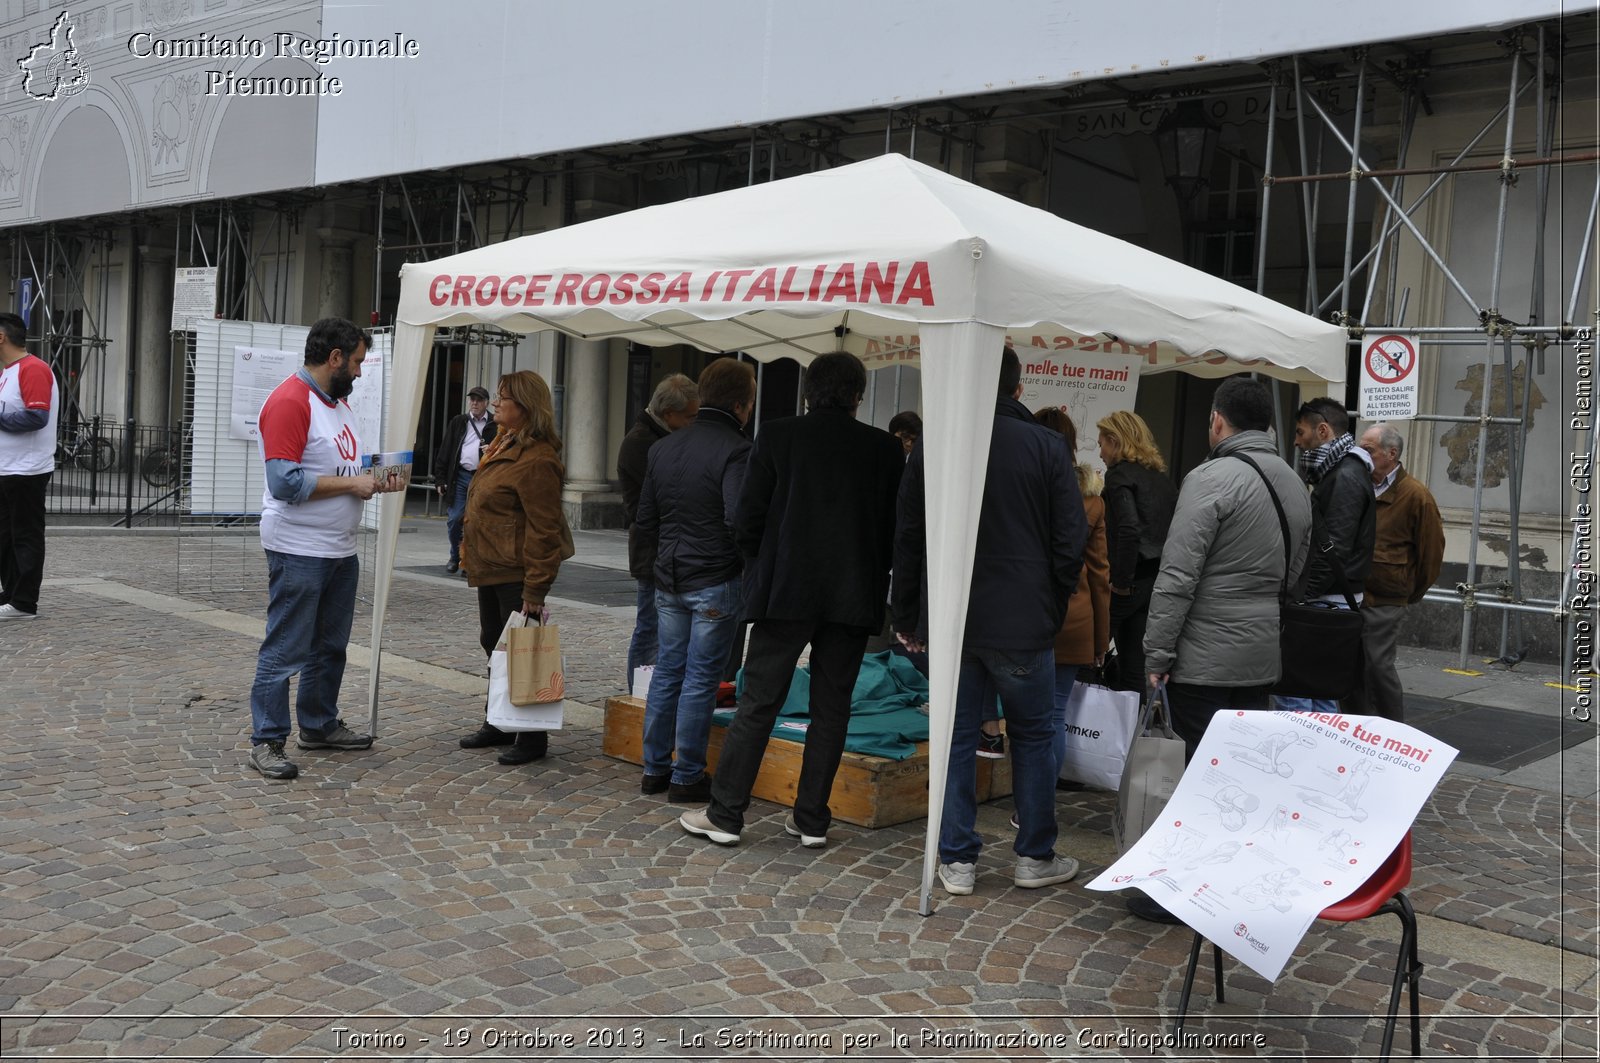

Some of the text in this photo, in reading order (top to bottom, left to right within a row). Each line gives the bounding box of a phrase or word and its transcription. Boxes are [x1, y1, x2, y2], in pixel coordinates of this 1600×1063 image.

[1077, 111, 1126, 132] SAN
[428, 260, 935, 307] CROCE ROSSA ITALIANA
[1025, 359, 1129, 382] nelle tue mani
[1042, 378, 1054, 386] un
[1055, 379, 1085, 389] arresto
[1087, 381, 1126, 393] cardiaco
[1364, 385, 1414, 394] VIETATO SALIRE
[1374, 393, 1409, 401] SCENDERE
[1273, 711, 1323, 734] affrontare
[1324, 730, 1339, 741] un
[1339, 735, 1376, 757] arresto
[1377, 751, 1421, 773] cardiaco
[1307, 711, 1433, 763] nelle tue mani
[1245, 932, 1270, 953] Laerdal
